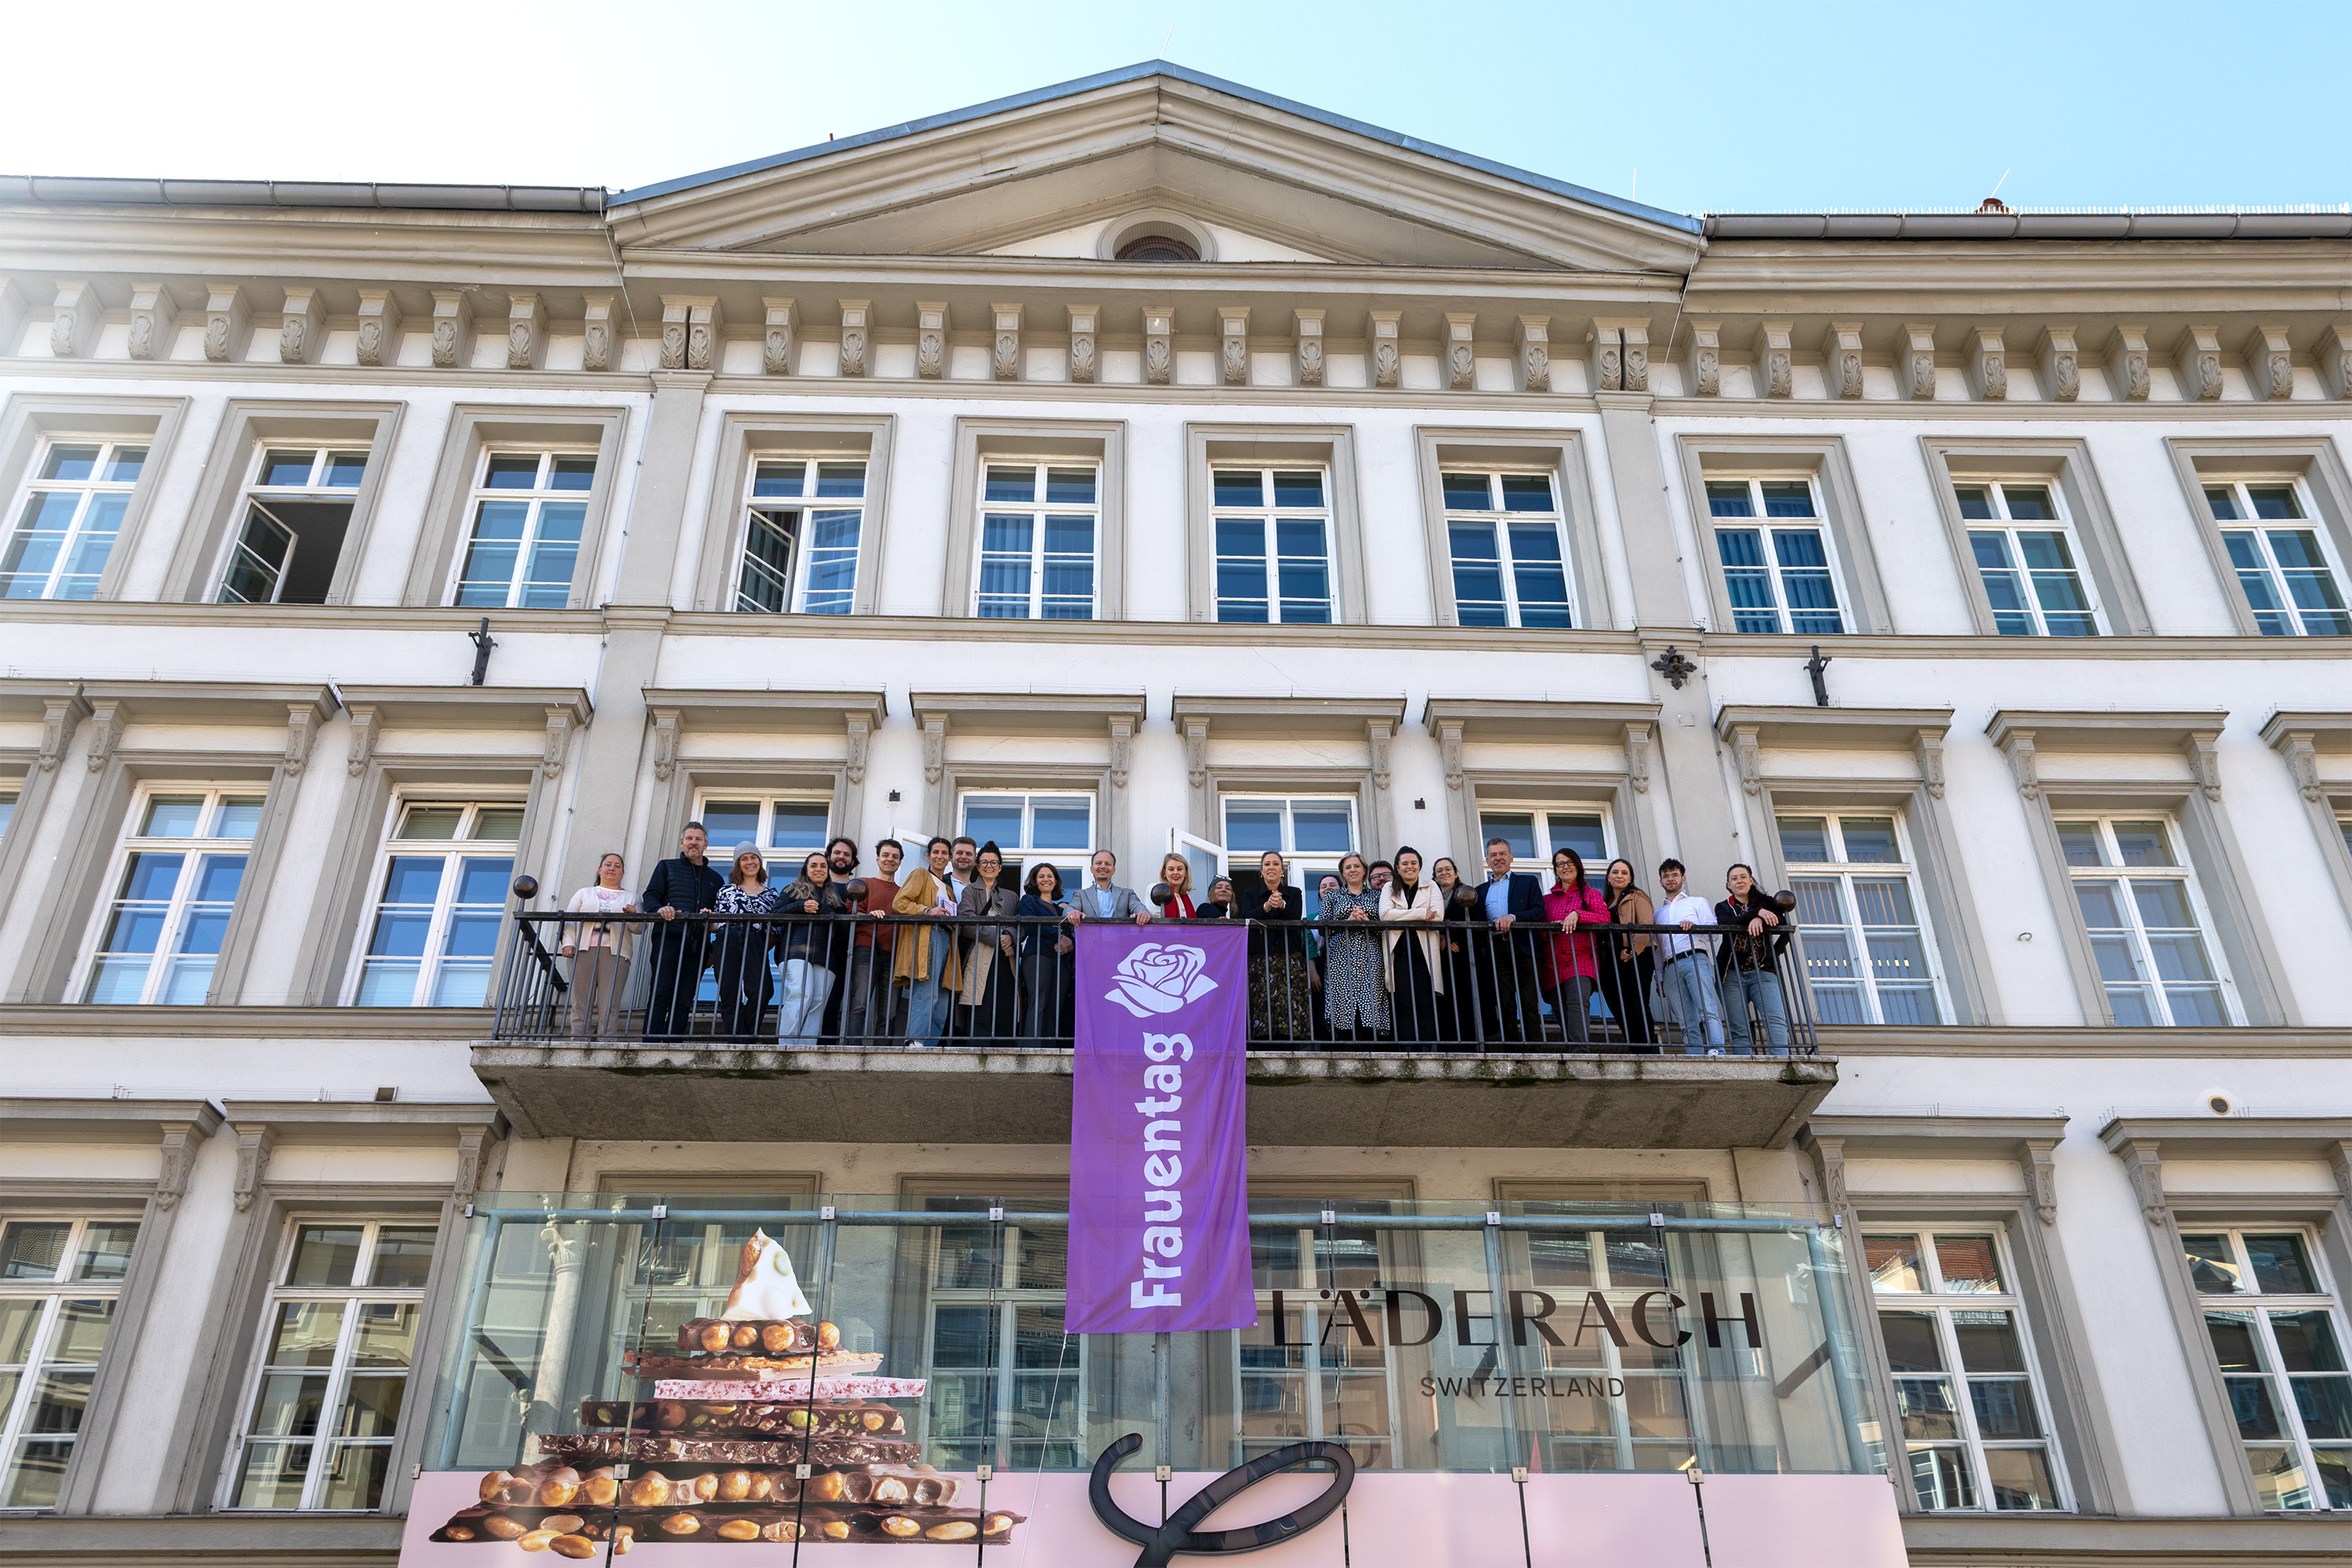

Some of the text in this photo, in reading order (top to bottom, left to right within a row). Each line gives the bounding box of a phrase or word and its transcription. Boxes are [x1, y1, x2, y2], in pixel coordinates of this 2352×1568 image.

[1131, 1032, 1193, 1308] Frauentag
[1272, 1289, 1762, 1348] LÄDERACH
[1421, 1377, 1625, 1398] SWITZERLAND
